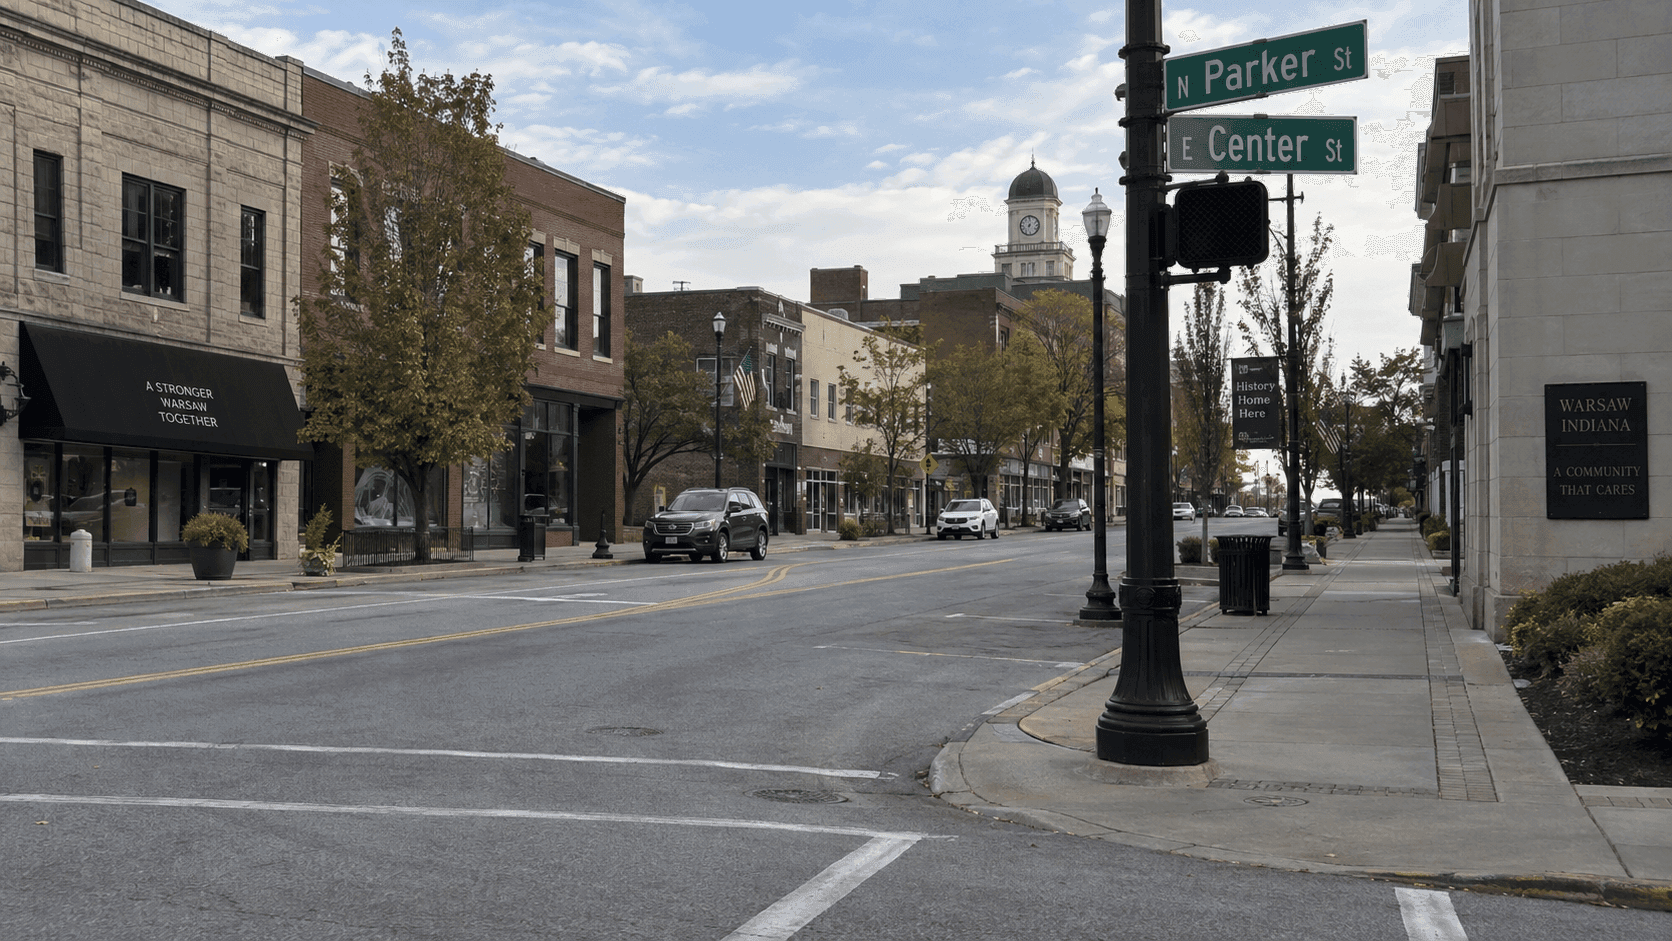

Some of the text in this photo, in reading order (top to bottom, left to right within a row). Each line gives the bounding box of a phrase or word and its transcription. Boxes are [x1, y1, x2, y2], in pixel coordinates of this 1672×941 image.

[1177, 46, 1353, 99] N Parker St
[1182, 125, 1343, 163] E Center St
[146, 381, 214, 399] A STRONGER
[1236, 381, 1275, 392] History
[160, 397, 207, 412] WARSAW
[1238, 395, 1271, 405] Home
[1560, 397, 1632, 412] WARSAW
[158, 411, 219, 428] TOGETHER
[1239, 409, 1266, 419] Here
[1561, 418, 1631, 432] INDIANA
[1553, 466, 1641, 477] A COMMUNITY
[1560, 484, 1635, 496] THAT CARES
